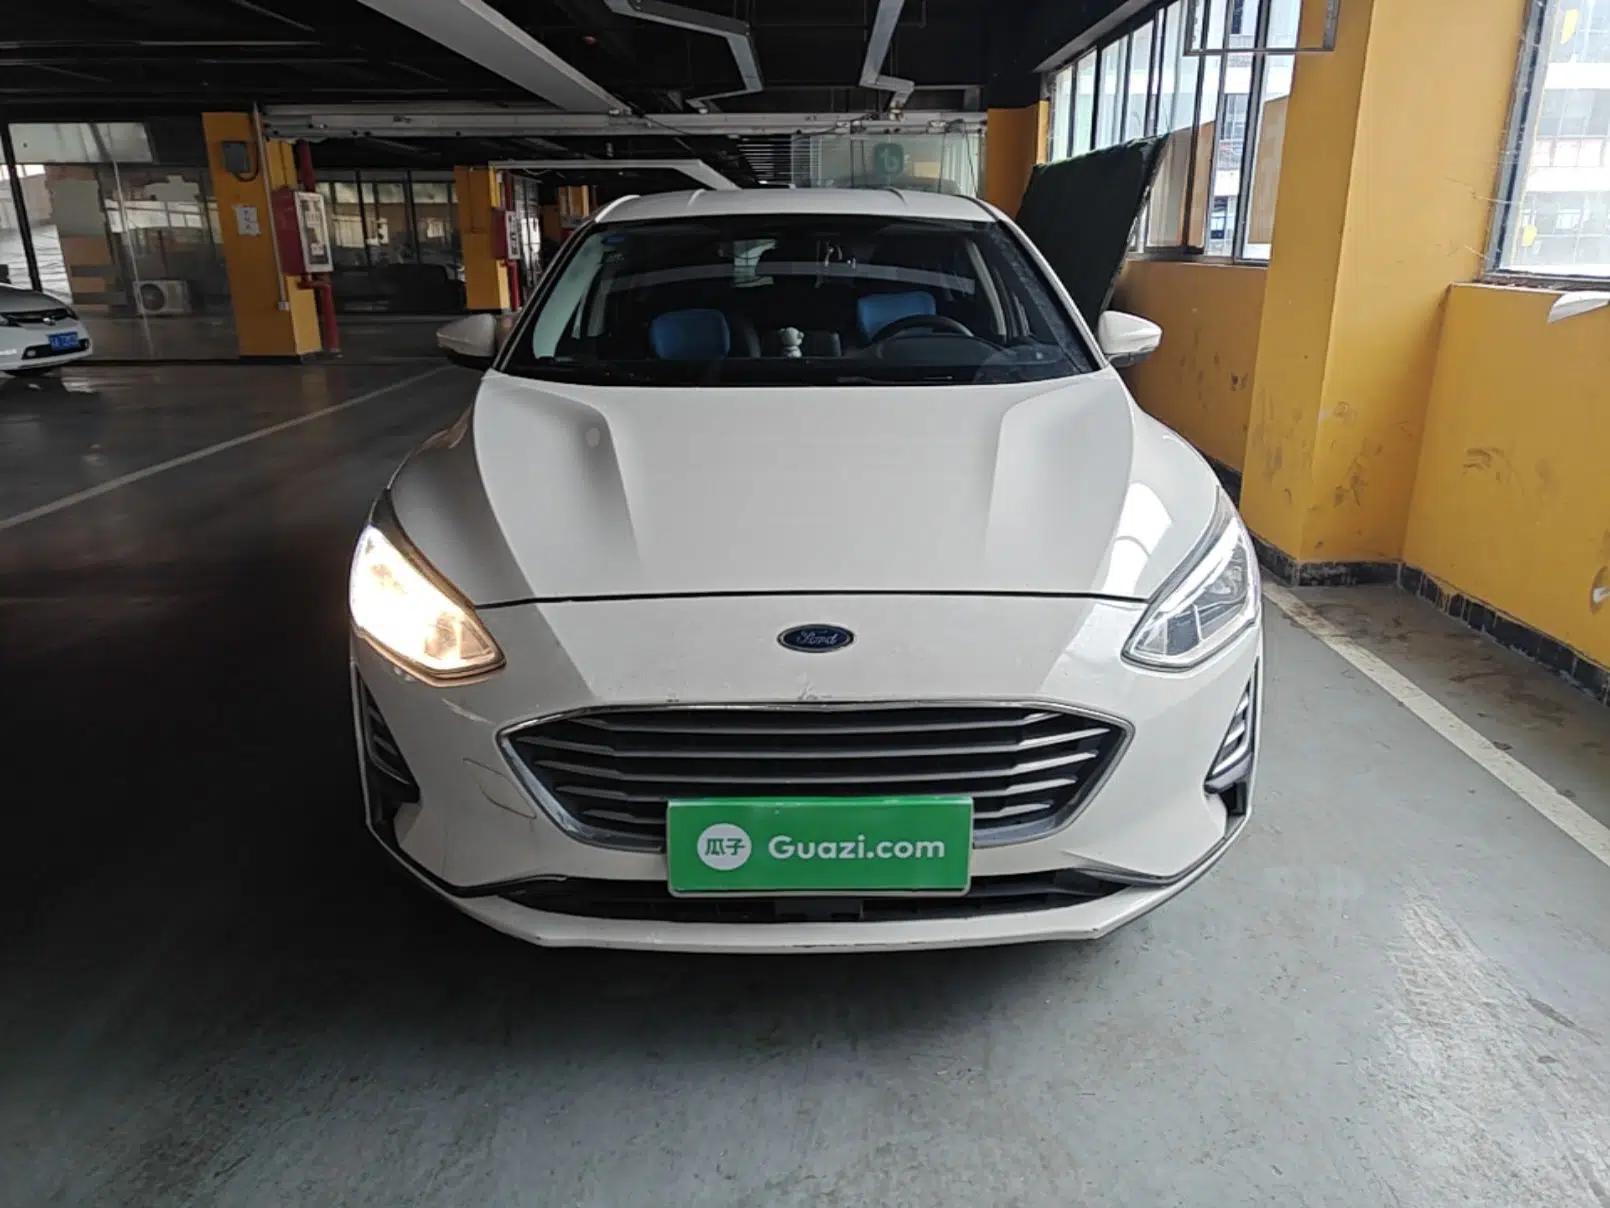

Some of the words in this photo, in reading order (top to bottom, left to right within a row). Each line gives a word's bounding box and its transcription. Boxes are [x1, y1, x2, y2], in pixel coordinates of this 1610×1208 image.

[798, 630, 839, 645] Ford
[704, 838, 746, 856] 瓜子
[768, 834, 945, 860] Guazi.com
